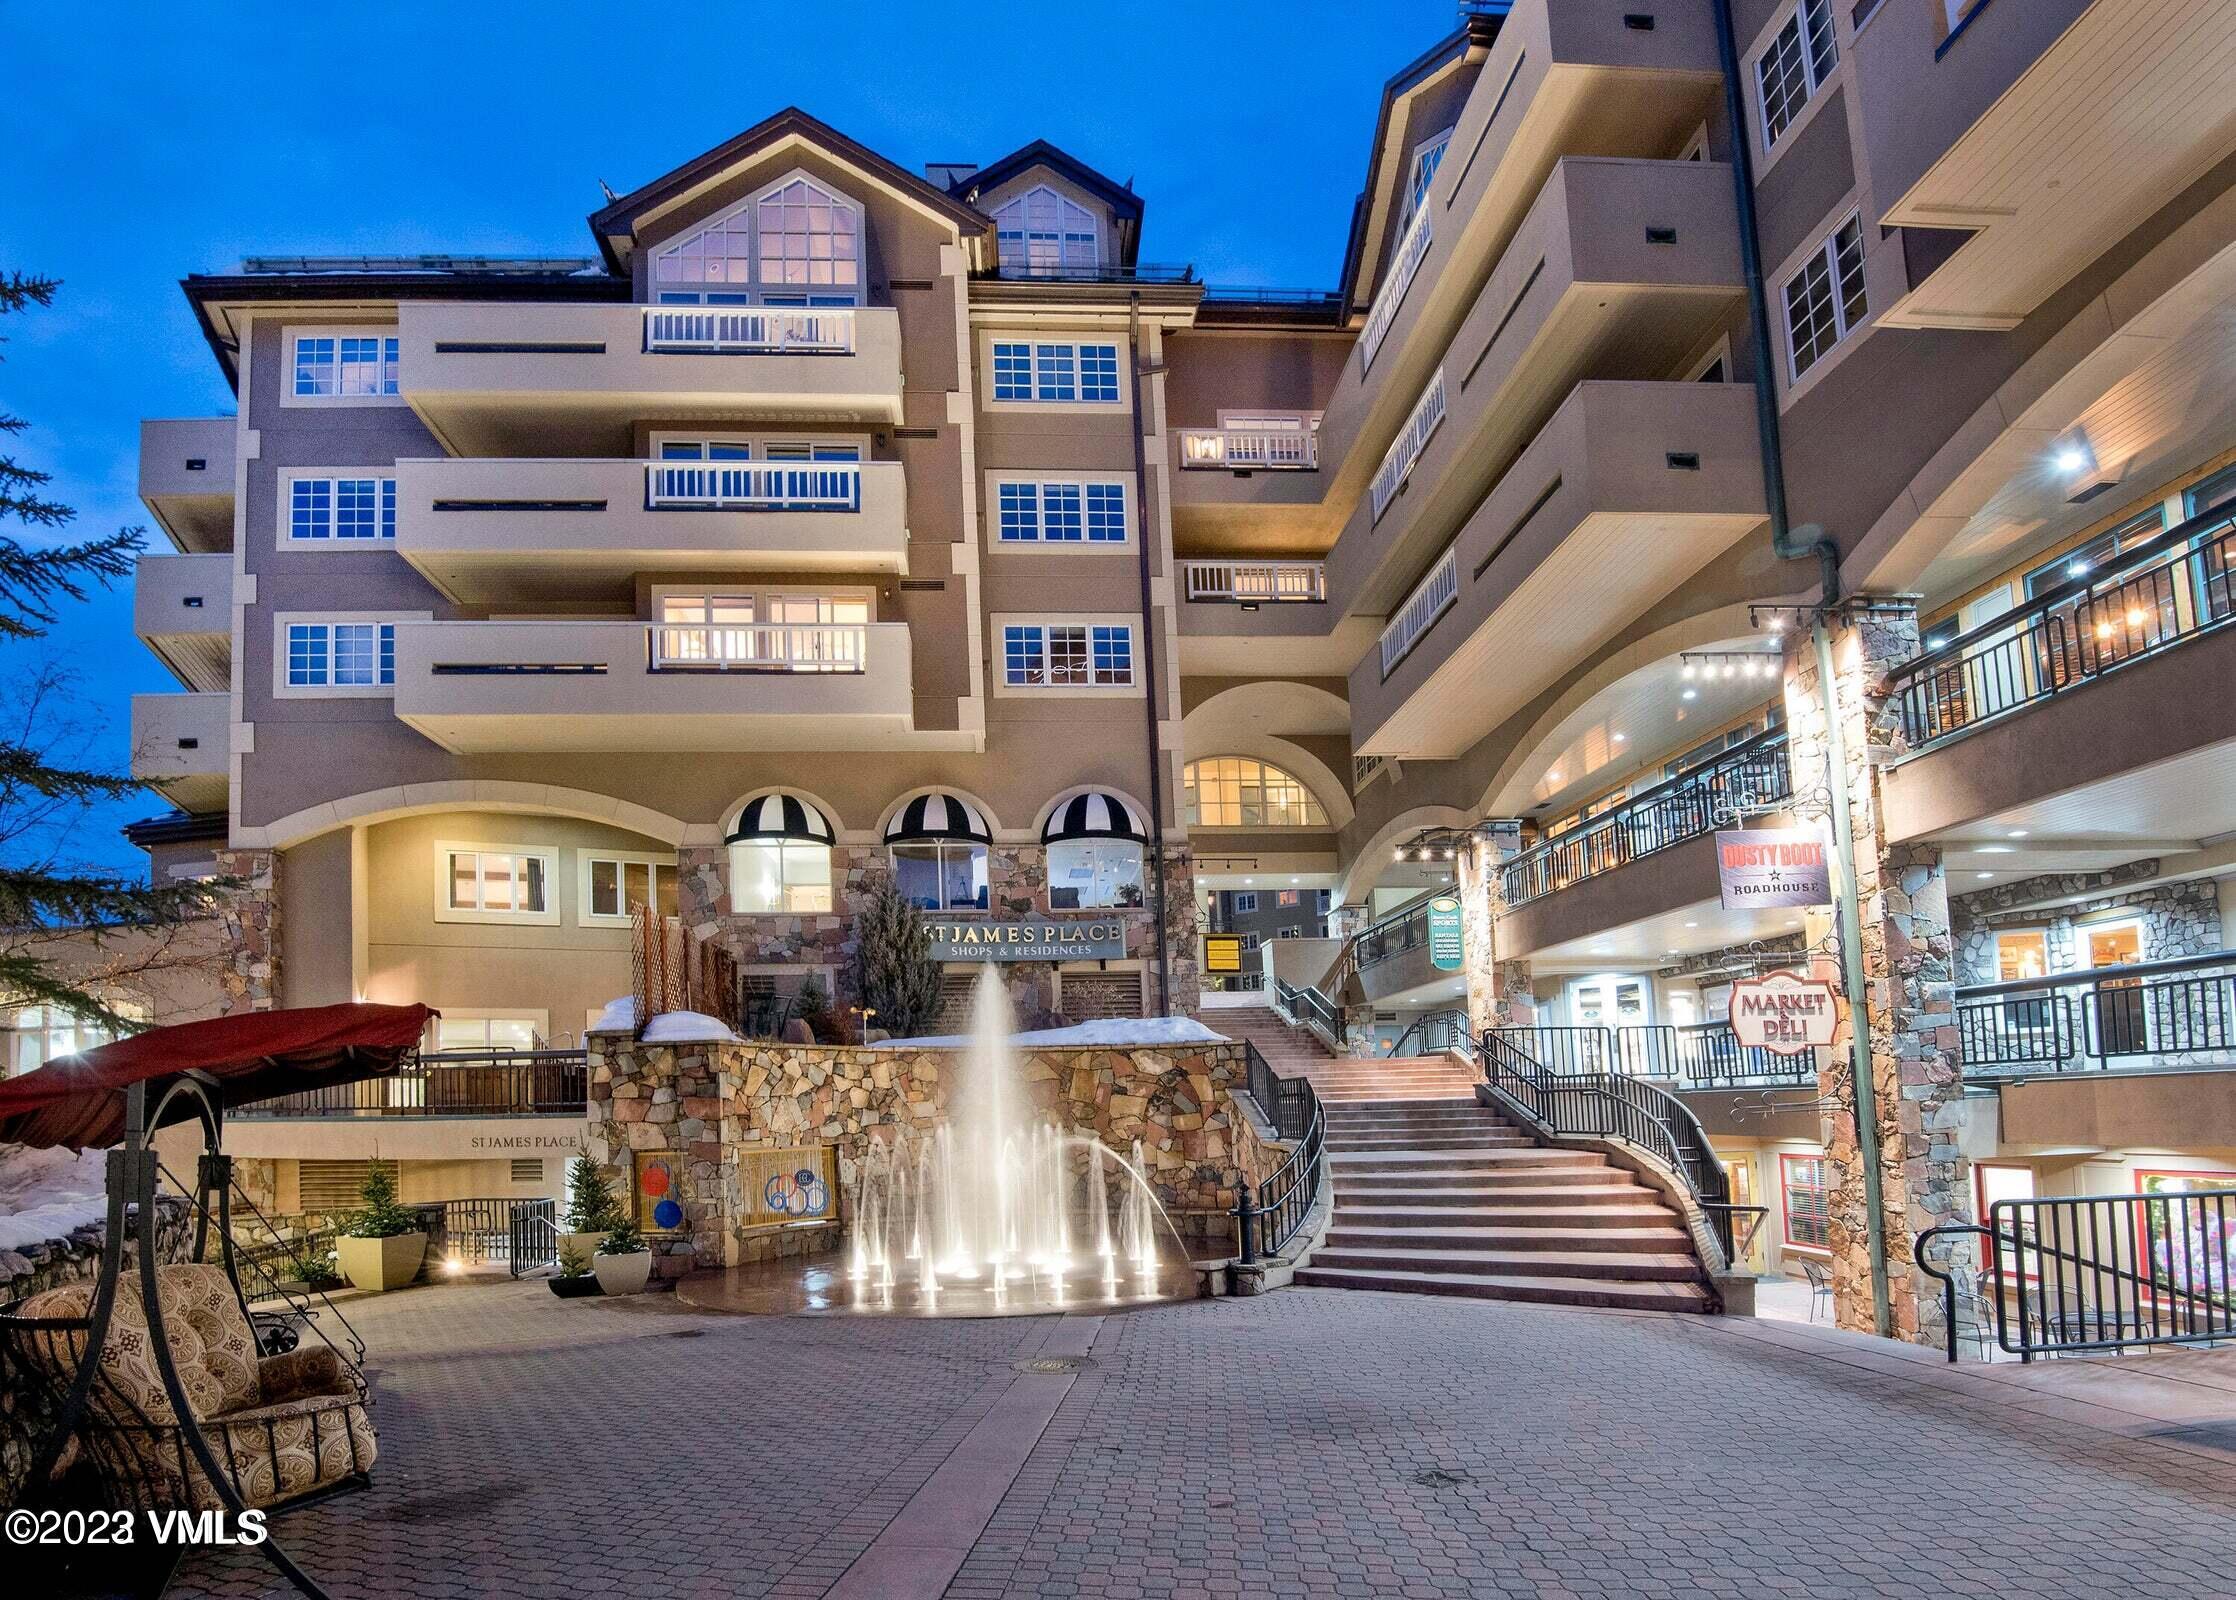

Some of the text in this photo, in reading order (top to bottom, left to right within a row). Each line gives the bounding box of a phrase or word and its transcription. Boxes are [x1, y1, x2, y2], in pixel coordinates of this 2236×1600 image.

[1723, 843, 1822, 869] DUSTY BOOT
[1734, 883, 1820, 895] ROADHOUSE
[922, 924, 1121, 944] ST JAMES PLACE
[951, 945, 1092, 956] SHOPS & RESIDENCES
[1742, 993, 1826, 1014] MARKET
[1763, 1019, 1808, 1038] DELI
[471, 1135, 577, 1148] ST JAMES PLACE
